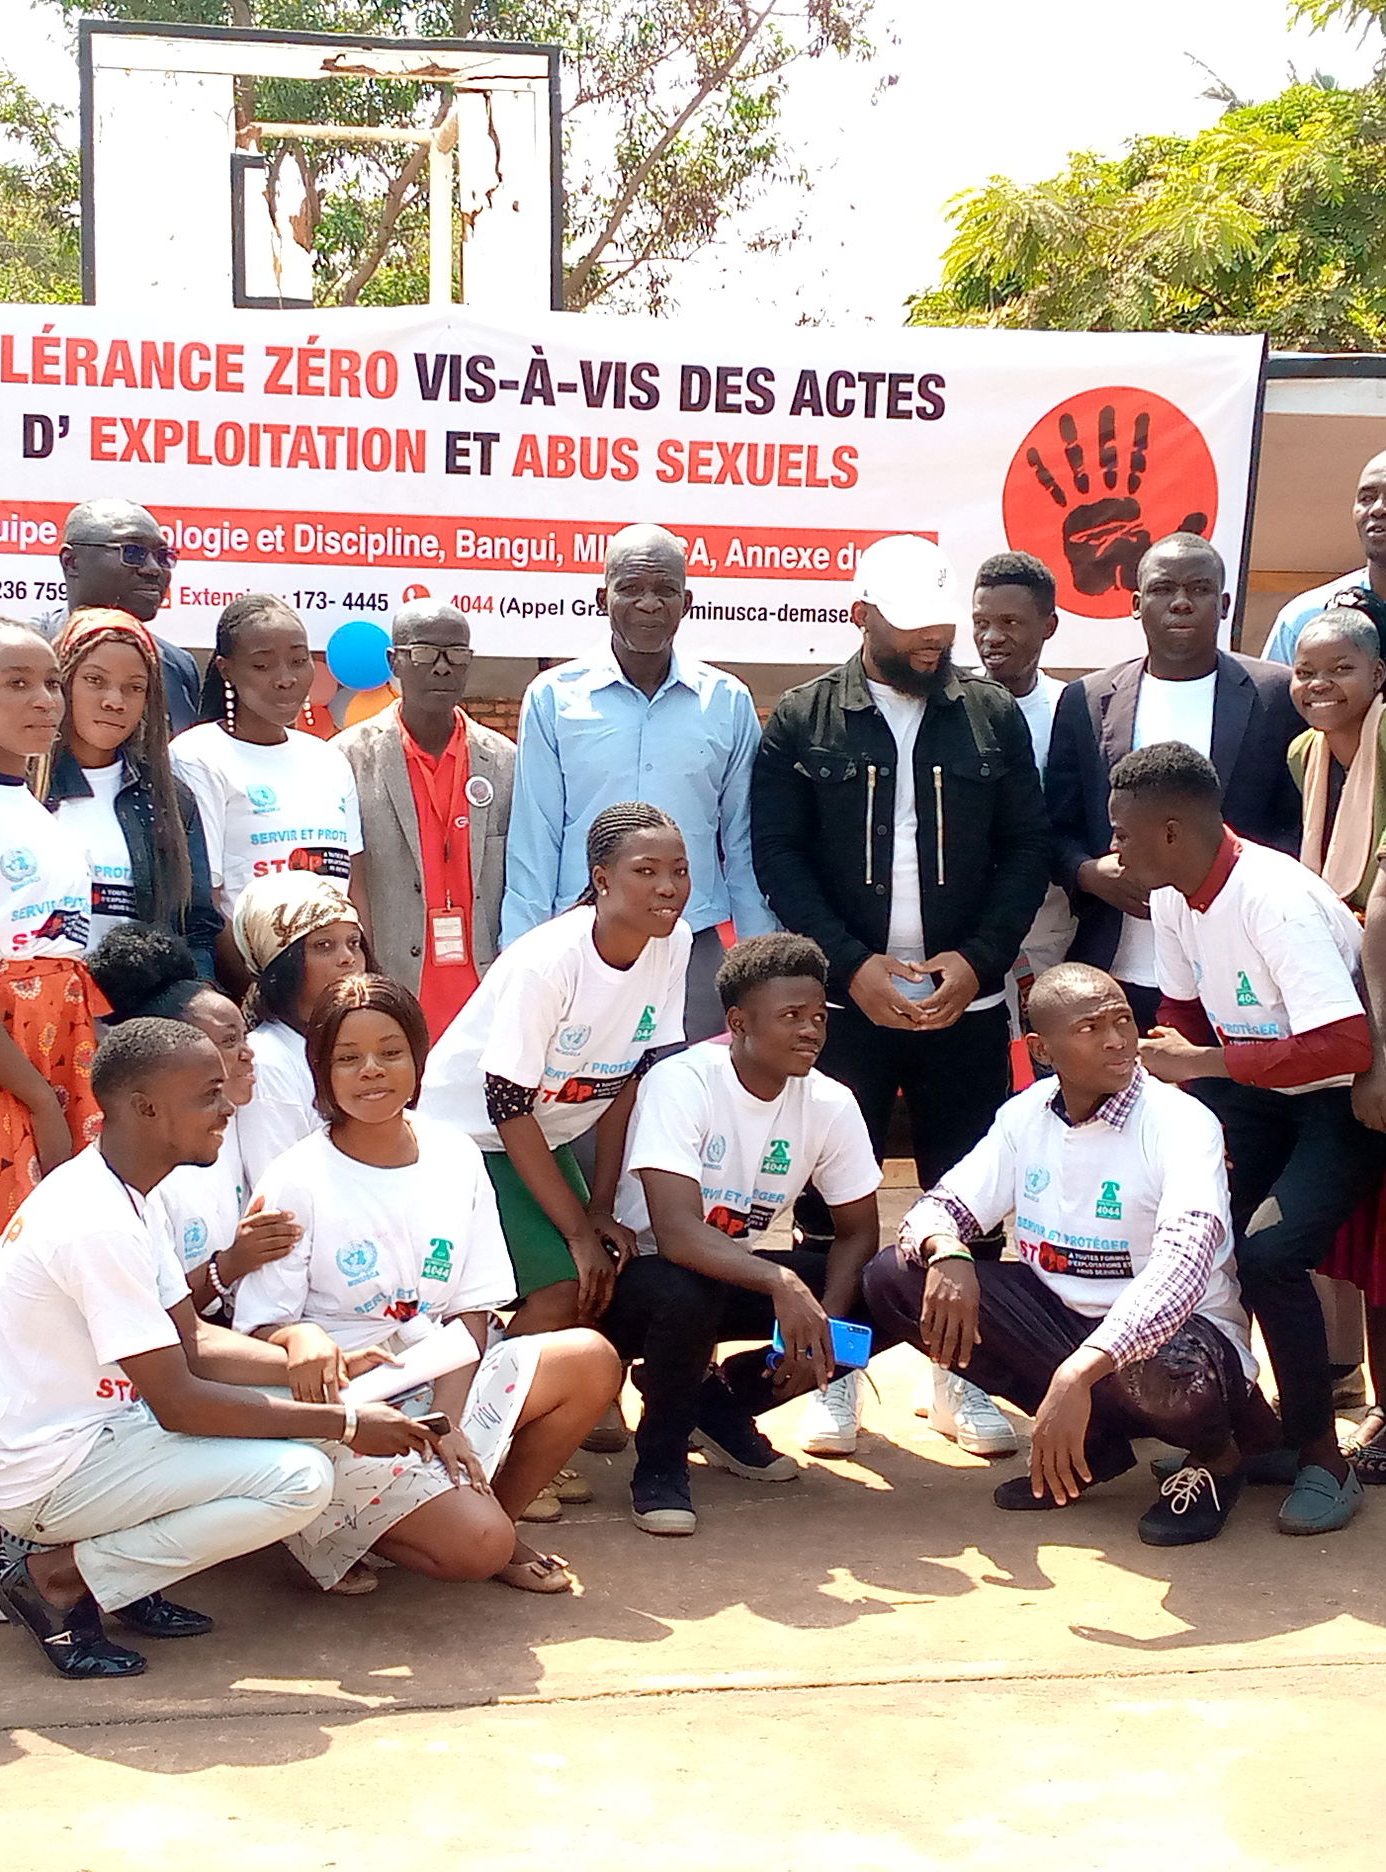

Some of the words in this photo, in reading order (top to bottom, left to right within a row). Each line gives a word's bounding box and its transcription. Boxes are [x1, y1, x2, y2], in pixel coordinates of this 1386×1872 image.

[263, 335, 399, 400] ZÉRO
[413, 345, 660, 411] VIS-À-VIS
[679, 364, 776, 416] DES
[789, 369, 947, 422] ACTES
[90, 416, 426, 474] EXPLOITATION
[445, 430, 500, 476] ET
[512, 433, 639, 482] ABUS
[656, 439, 860, 490] SEXUELS
[158, 519, 251, 559] ologie
[256, 524, 287, 553] et
[294, 522, 446, 563] Discipline,
[455, 529, 565, 573] Bangui,
[724, 537, 831, 571] Annexe
[342, 592, 389, 612] 4445
[499, 596, 564, 619] (Appel
[249, 829, 297, 846] SERVIR
[300, 828, 315, 841] ET
[1096, 1205, 1121, 1217] 4044
[424, 1263, 452, 1279] 4044
